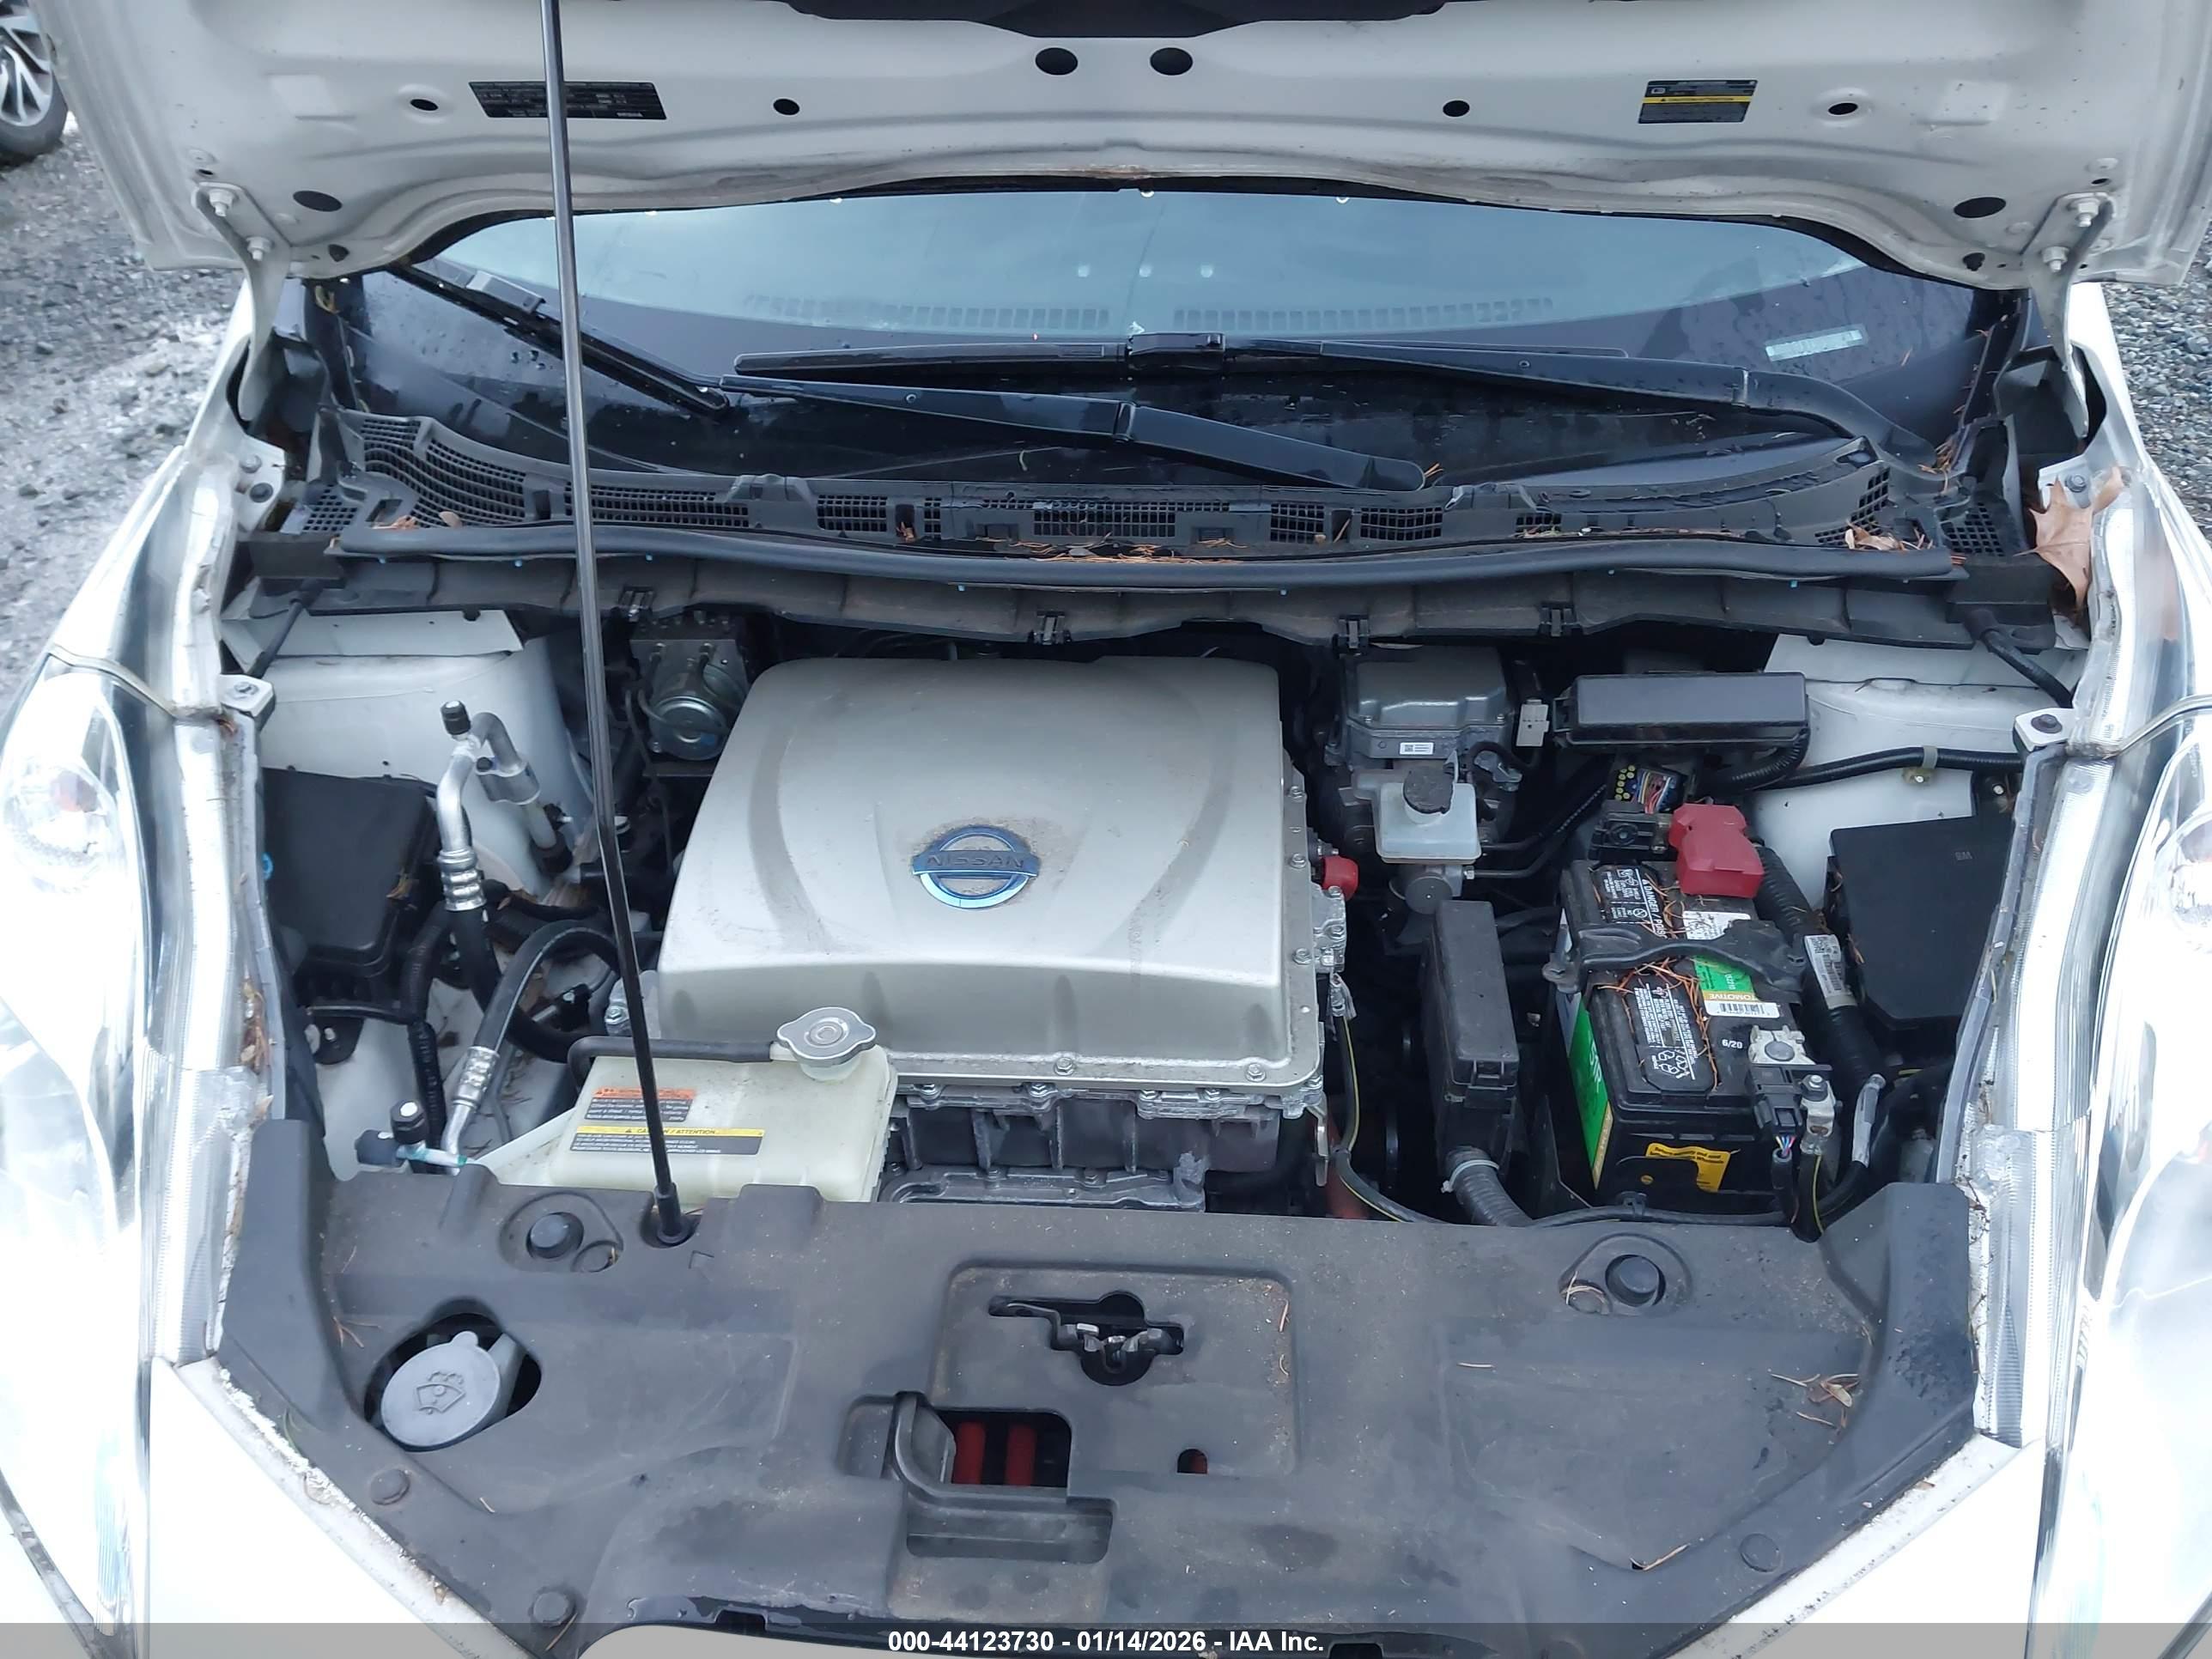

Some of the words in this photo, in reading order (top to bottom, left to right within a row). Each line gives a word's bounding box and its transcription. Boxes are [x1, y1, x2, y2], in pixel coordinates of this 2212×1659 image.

[927, 854, 1025, 869] NISSAN
[1644, 885, 1660, 913] DANGER
[1722, 1038, 1743, 1049] 6/20
